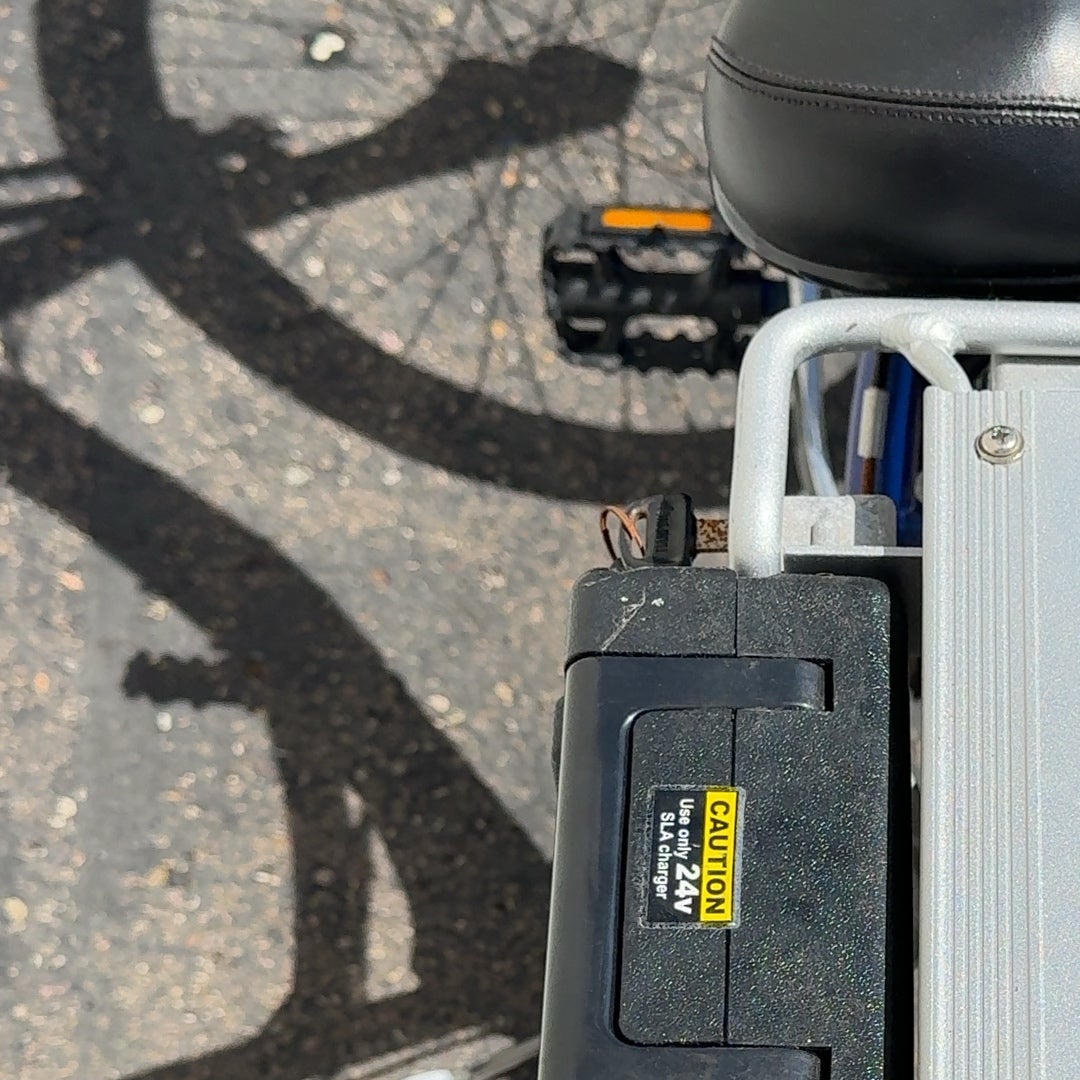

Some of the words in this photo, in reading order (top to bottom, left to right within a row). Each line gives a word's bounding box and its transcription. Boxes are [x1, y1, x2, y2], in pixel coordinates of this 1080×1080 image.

[658, 812, 675, 842] SLA
[678, 798, 695, 825] Use
[673, 829, 692, 860] only
[705, 800, 730, 915] CAUTION
[653, 844, 673, 900] charger
